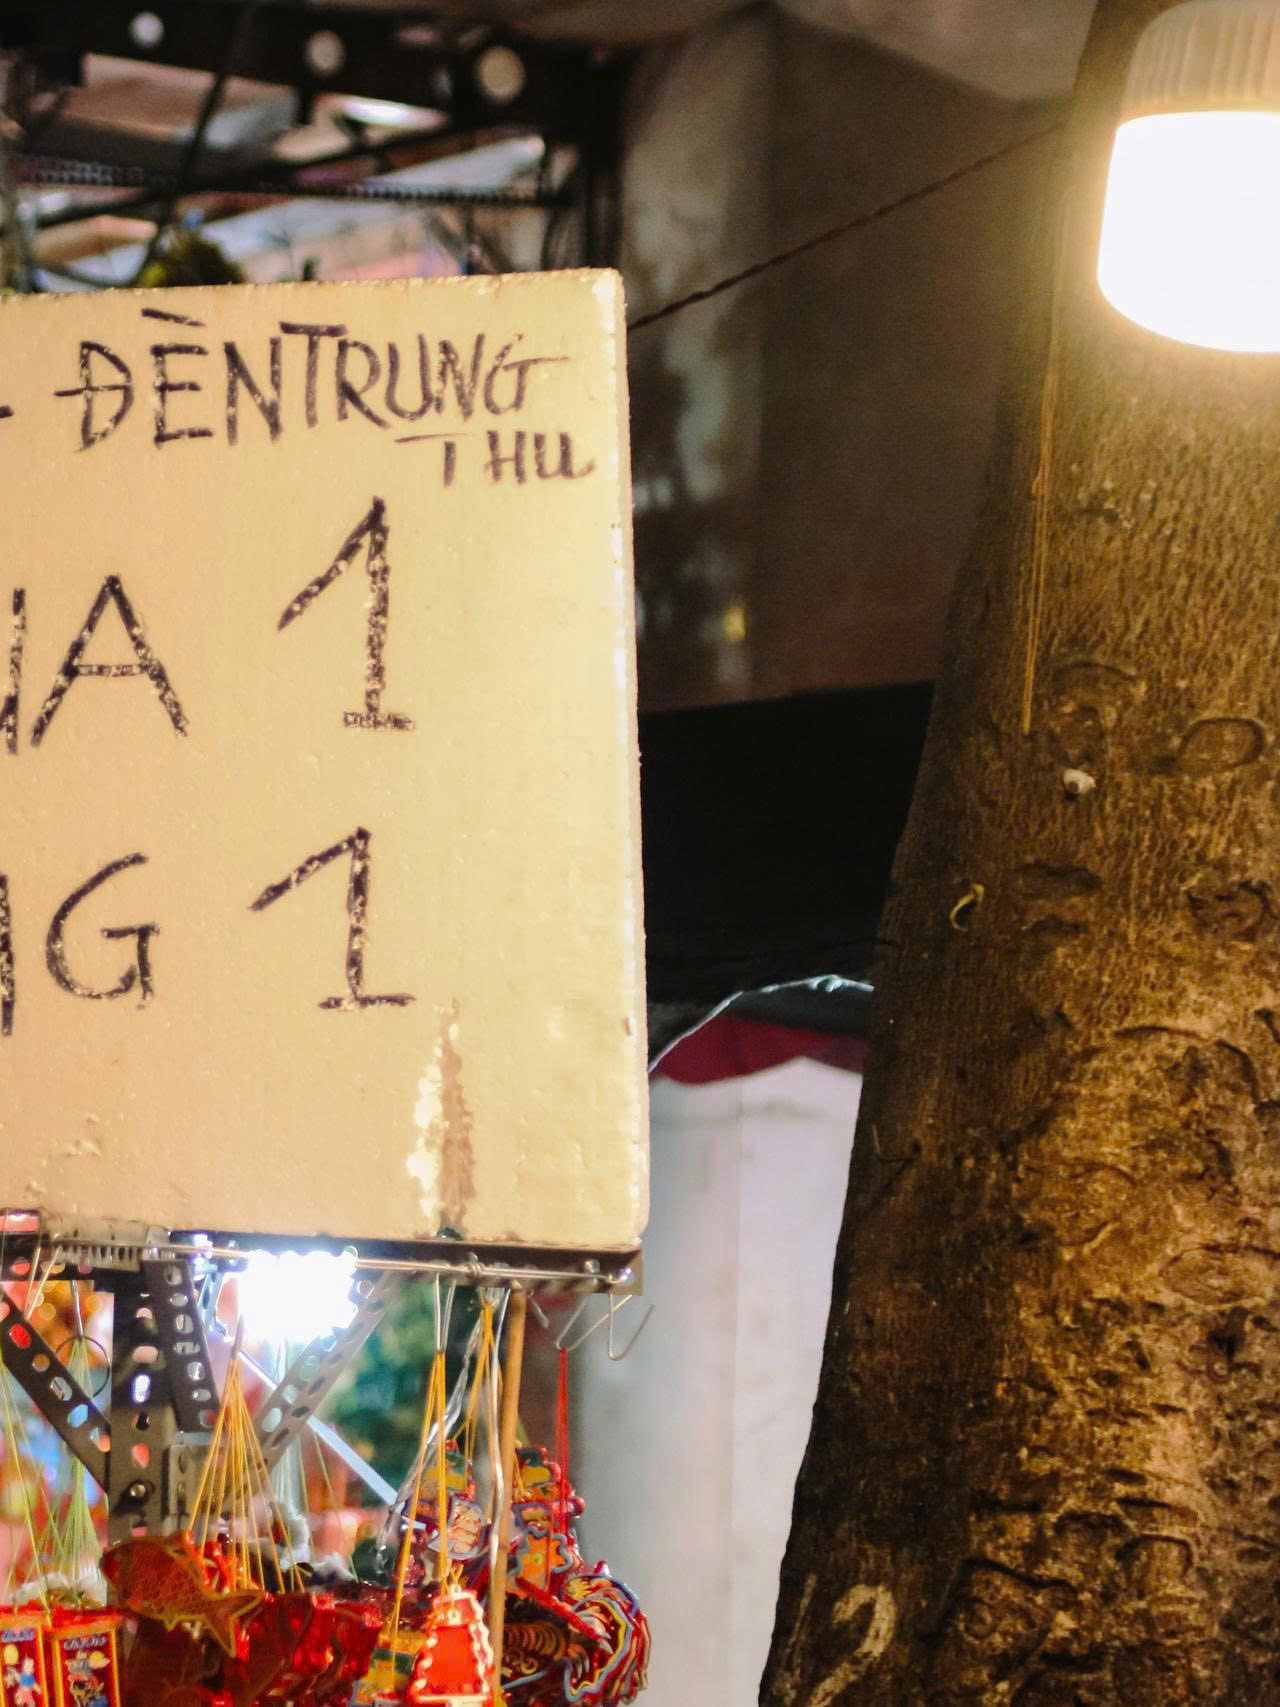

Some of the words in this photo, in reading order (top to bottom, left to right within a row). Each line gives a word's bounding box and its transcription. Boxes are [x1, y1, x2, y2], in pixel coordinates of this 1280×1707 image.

[54, 308, 283, 450] ĐÈN
[396, 432, 596, 487] THU
[277, 497, 414, 731] 1
[251, 827, 414, 1010] 1
